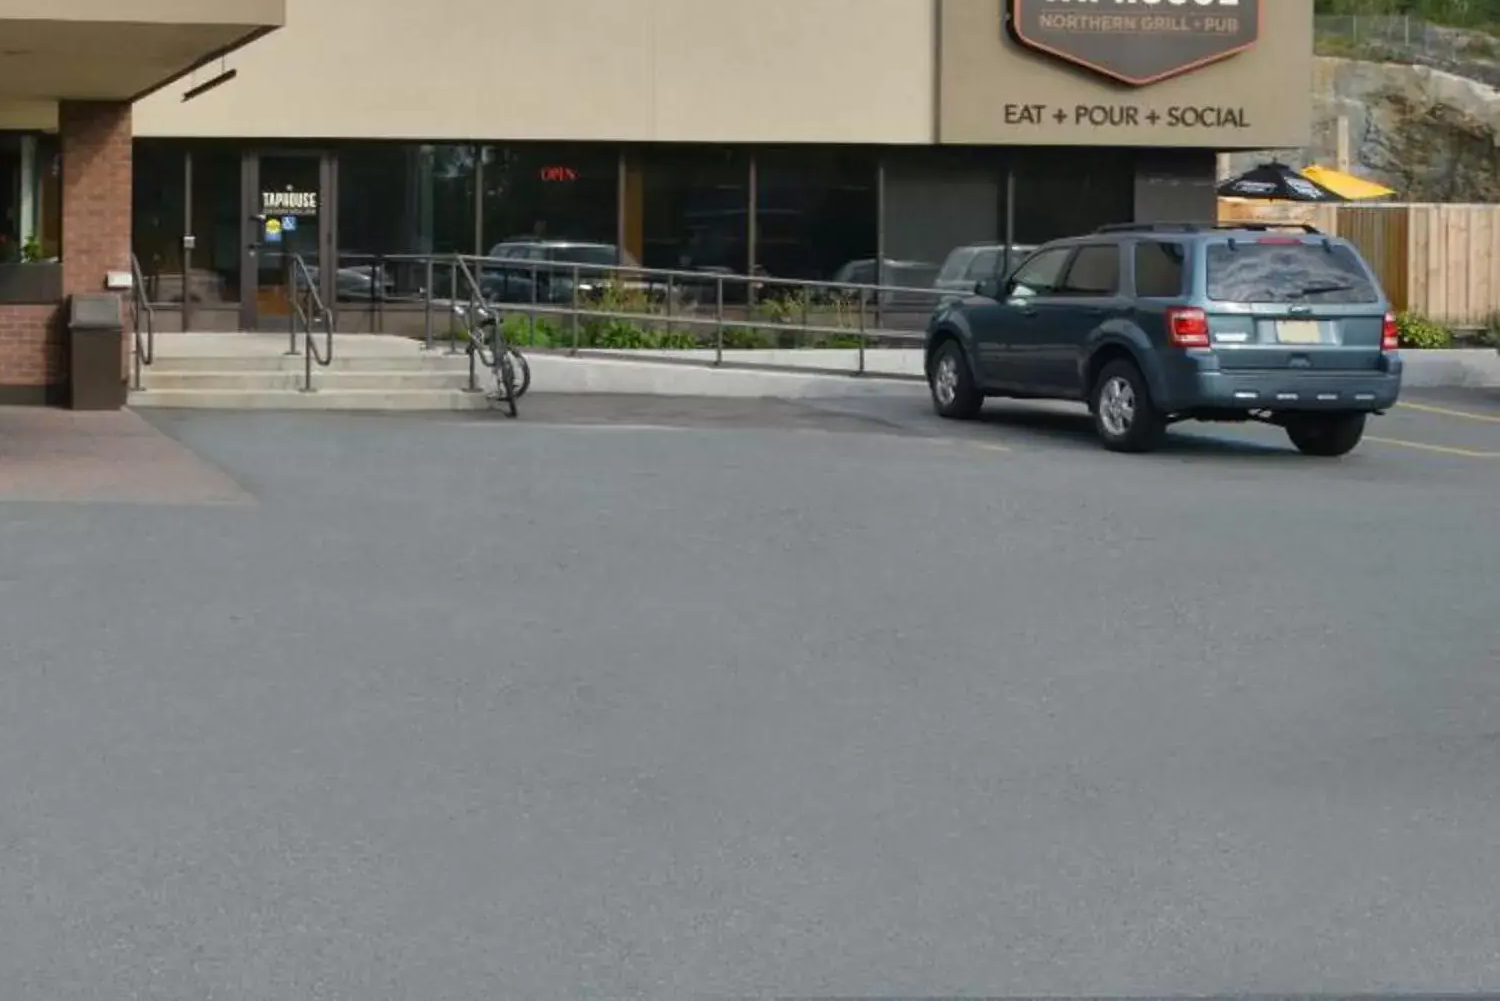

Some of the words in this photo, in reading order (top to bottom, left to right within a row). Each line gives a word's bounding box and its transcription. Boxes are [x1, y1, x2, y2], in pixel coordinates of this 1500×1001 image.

[1040, 13, 1136, 32] NORTHERN
[1141, 15, 1190, 32] GRILL
[1204, 17, 1239, 33] PUB
[1004, 104, 1047, 125] EAT
[1075, 105, 1139, 126] POUR
[1166, 106, 1251, 128] SOCIAL
[262, 192, 317, 208] TAPHOUSE
